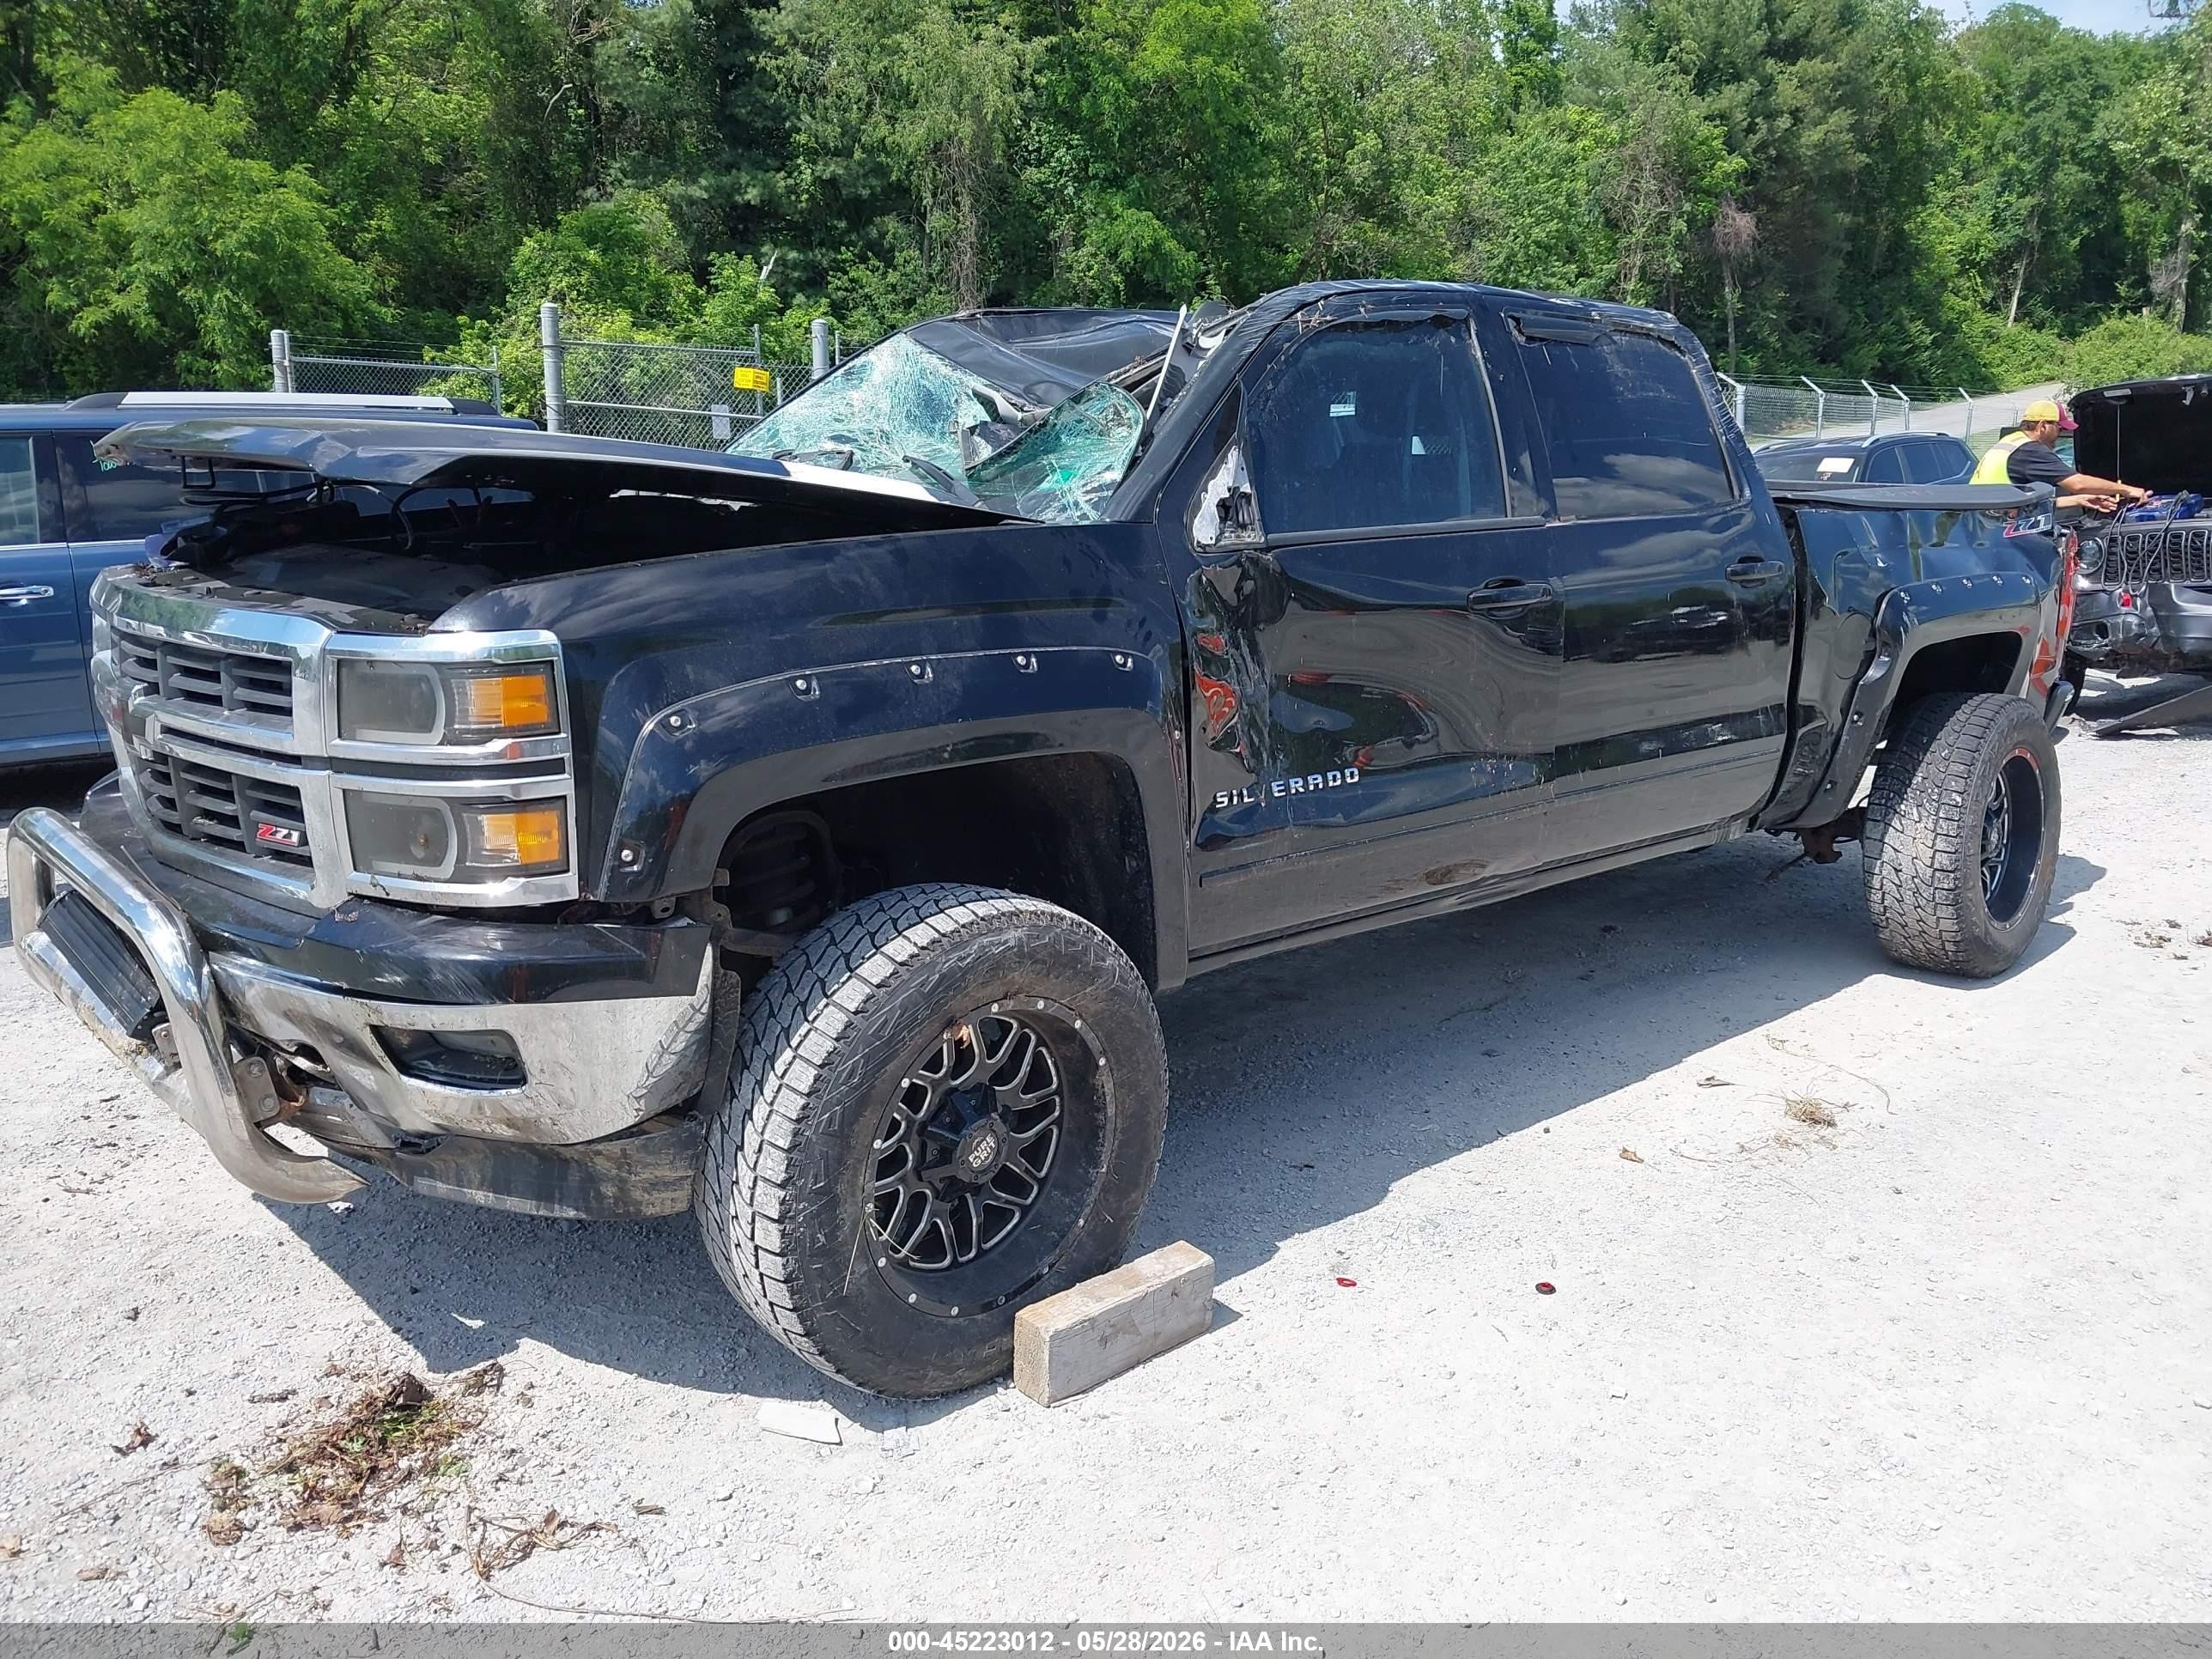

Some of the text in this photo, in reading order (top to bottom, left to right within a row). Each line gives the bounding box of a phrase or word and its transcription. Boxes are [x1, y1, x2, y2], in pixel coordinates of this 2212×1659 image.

[2002, 513, 2052, 538] Z71
[1215, 767, 1360, 811] SILVERADO
[256, 823, 301, 848] Z71
[968, 1133, 994, 1163] PURE
[972, 1139, 996, 1168] GRIT
